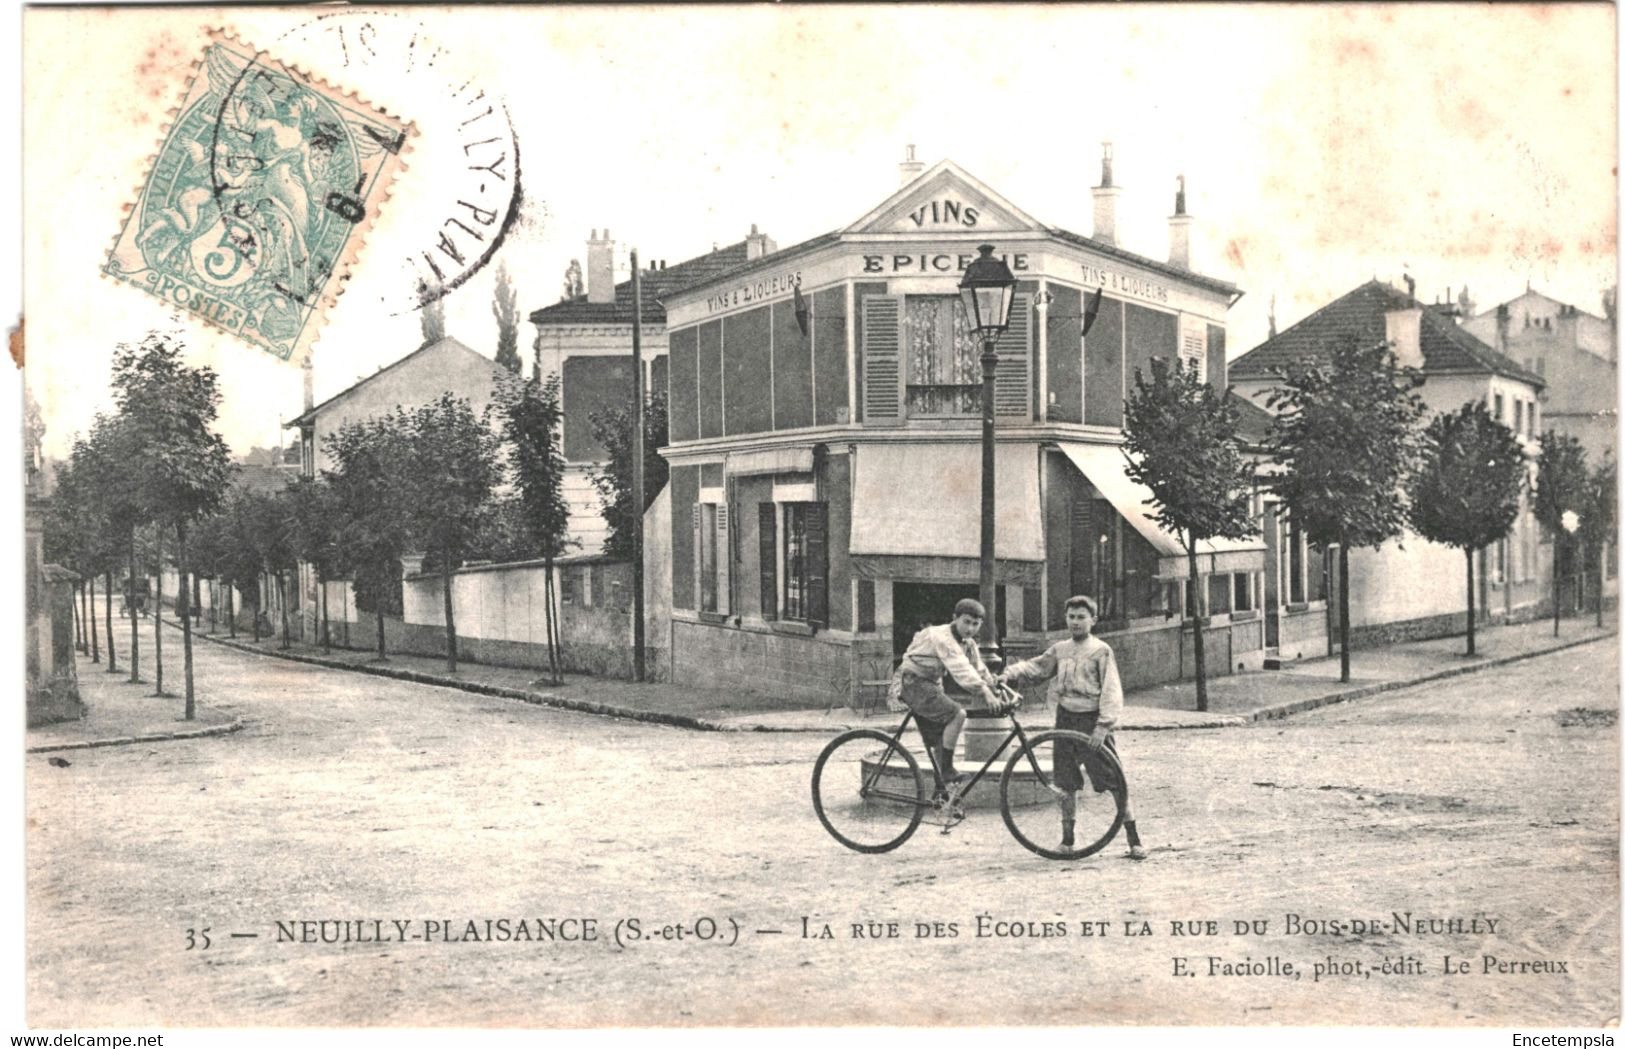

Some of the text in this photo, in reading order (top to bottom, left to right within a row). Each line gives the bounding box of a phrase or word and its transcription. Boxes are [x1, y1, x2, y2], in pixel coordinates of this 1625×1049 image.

[909, 199, 980, 228] VINS
[203, 217, 252, 281] 5
[707, 291, 730, 313] VINS
[743, 271, 803, 301] LIQUEURS
[1081, 264, 1107, 286] VINS
[158, 274, 243, 332] POSTES
[185, 926, 212, 951] 35
[275, 918, 599, 944] NEUILLY-PLAISANCE
[613, 916, 740, 949] (S.-et-O.)
[1172, 957, 1196, 978] E.
[1207, 956, 1301, 981] Faciolle,
[1443, 955, 1471, 976] Le
[1482, 955, 1570, 976] Perreux
